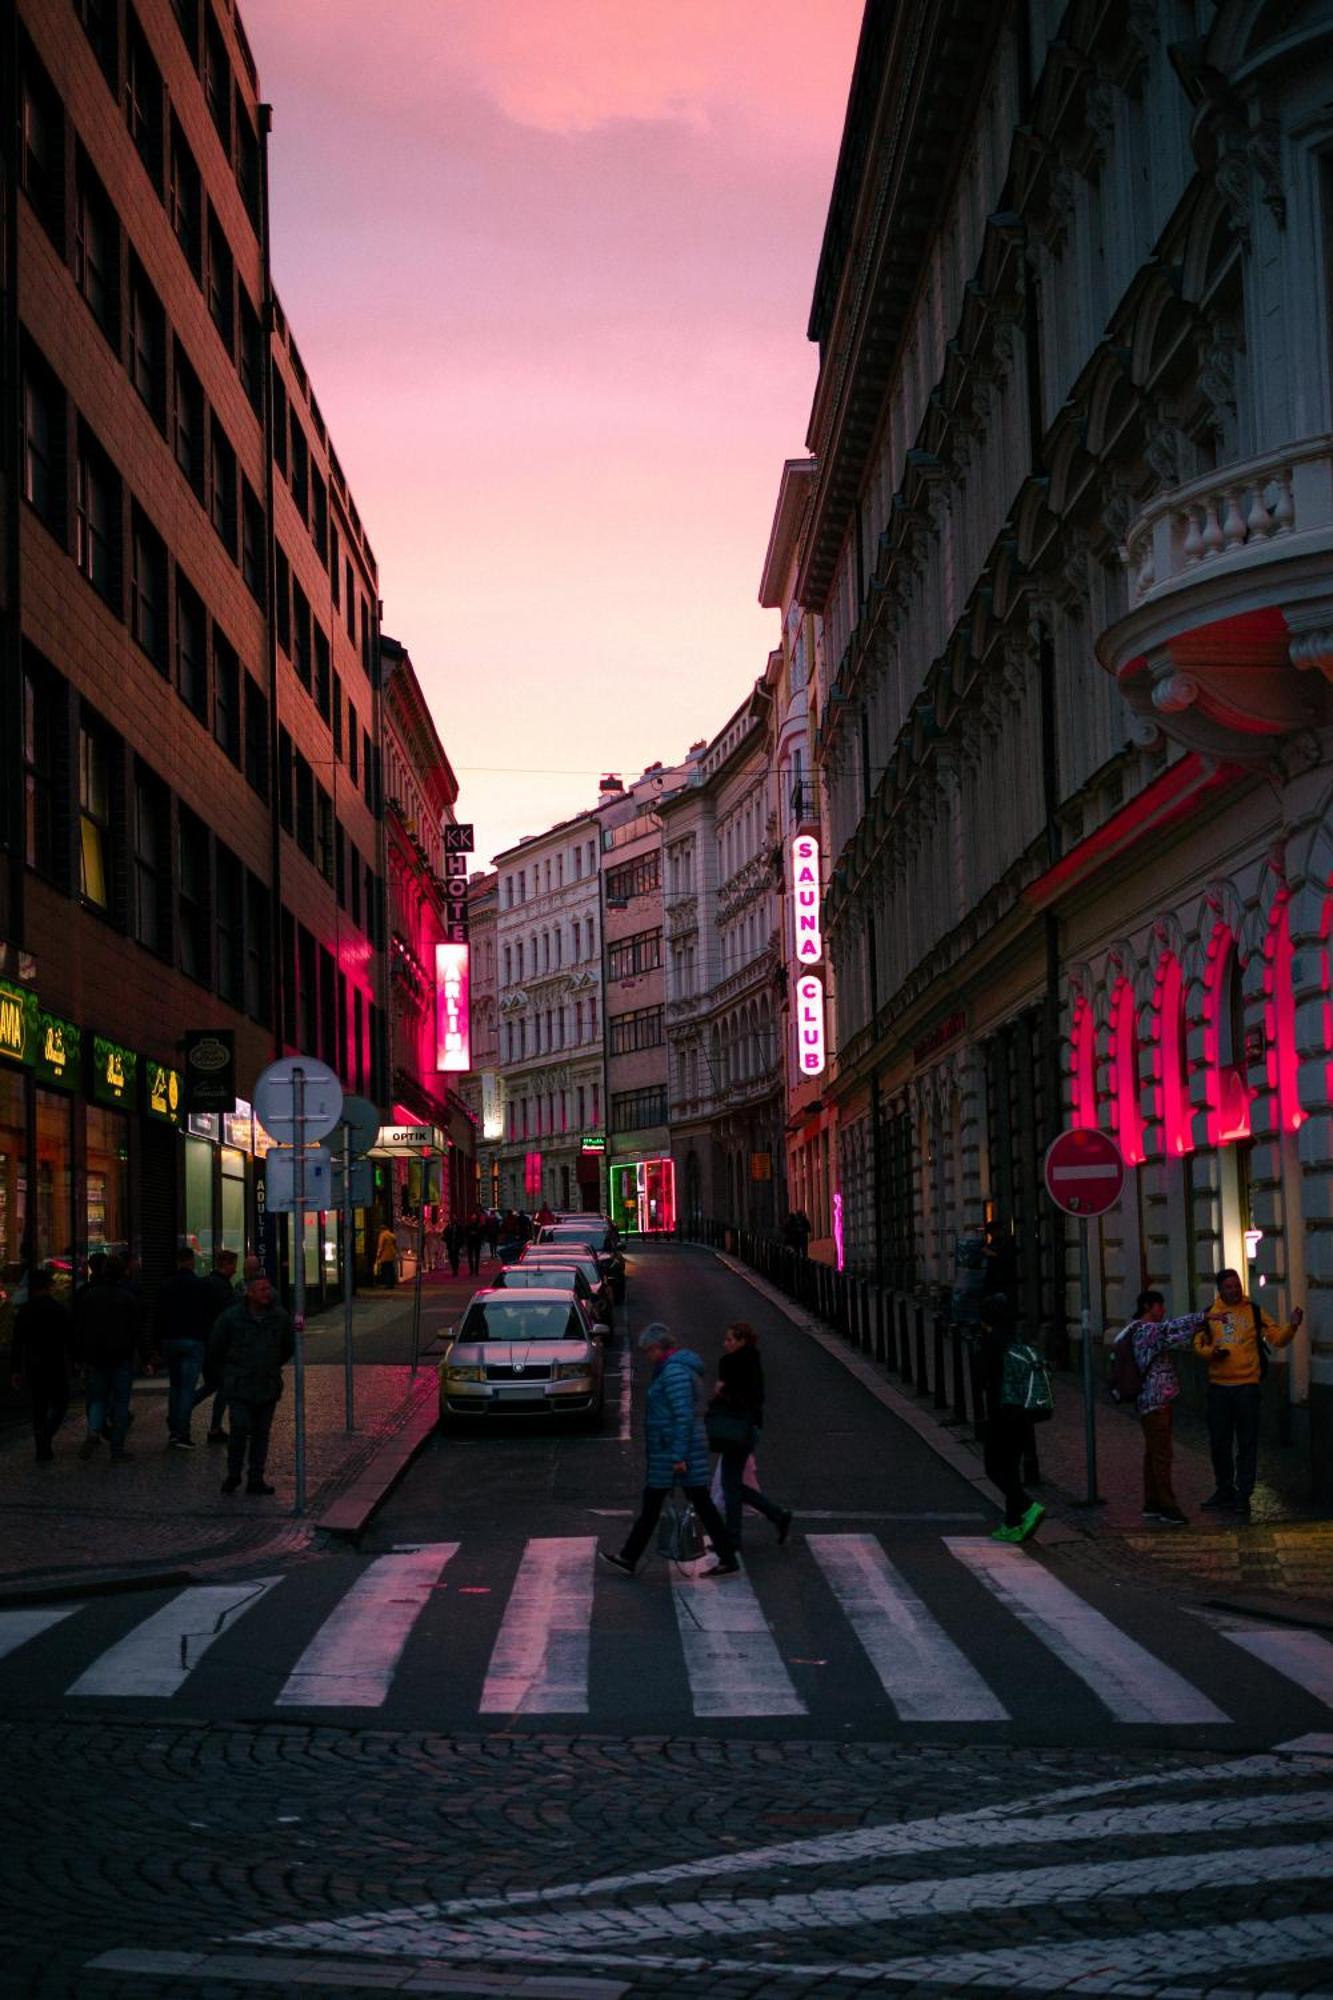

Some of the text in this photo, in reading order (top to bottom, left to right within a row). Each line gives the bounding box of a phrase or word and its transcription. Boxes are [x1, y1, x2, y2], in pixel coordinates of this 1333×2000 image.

[448, 856, 466, 942] HOTE
[799, 843, 819, 1068] SAUNA CLUB
[392, 1132, 427, 1141] OPTIK
[256, 1180, 265, 1237] ADULT
